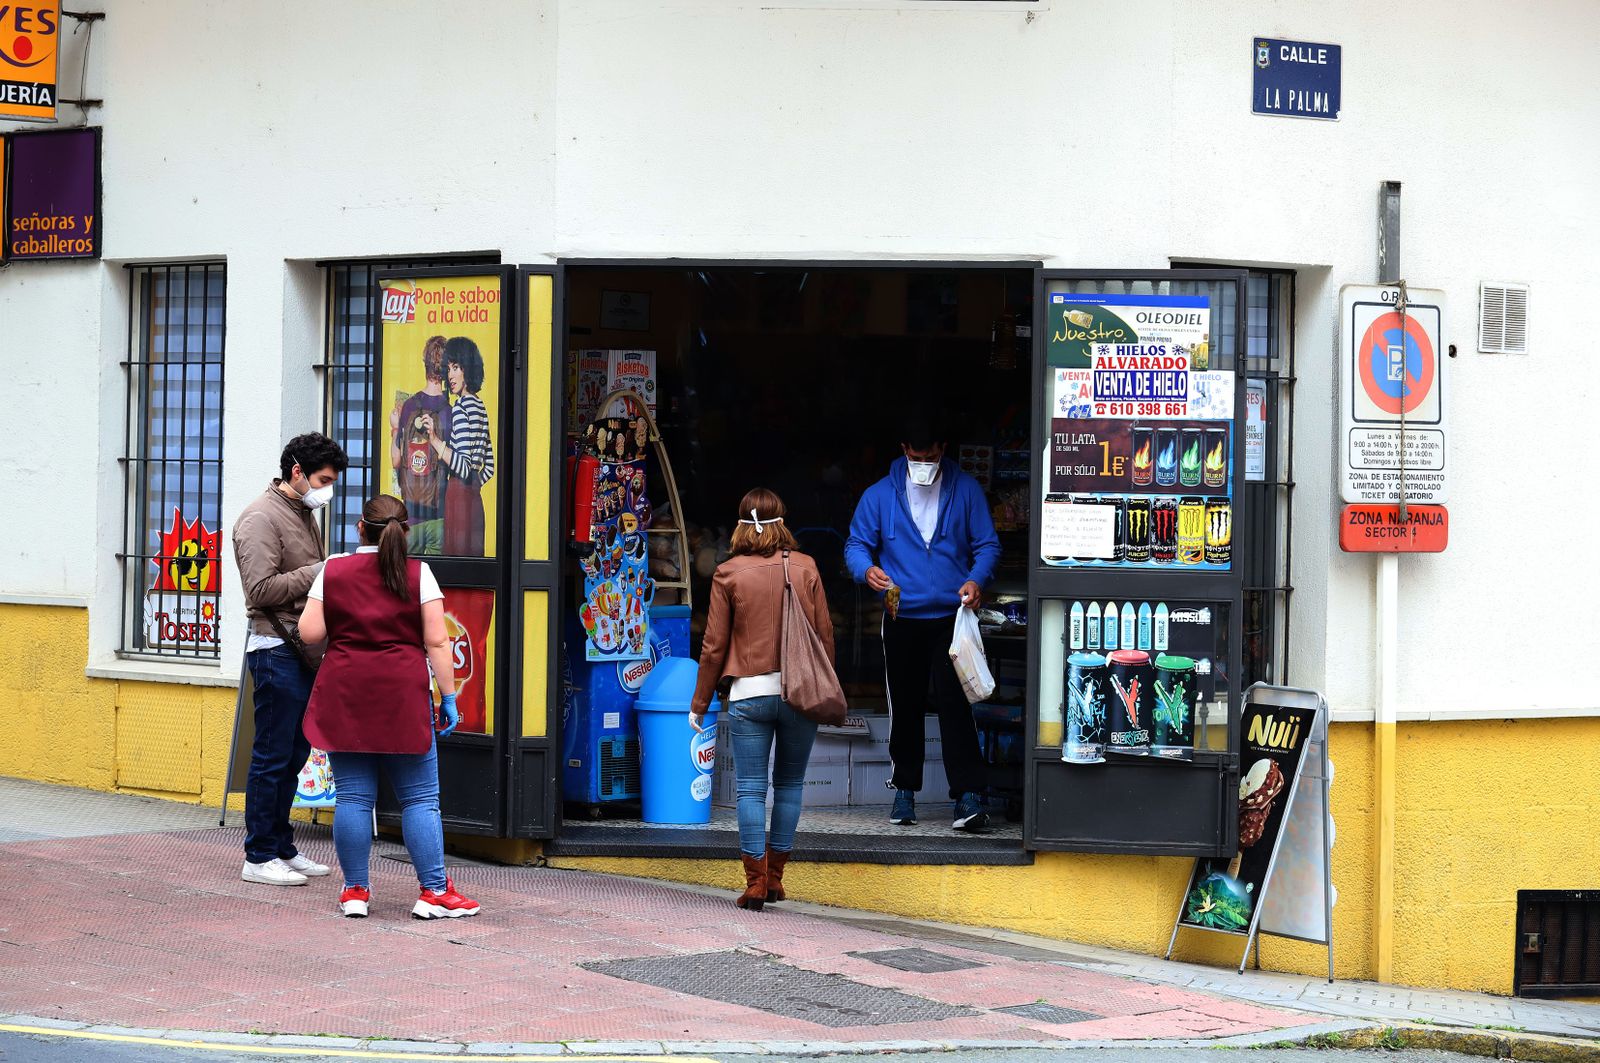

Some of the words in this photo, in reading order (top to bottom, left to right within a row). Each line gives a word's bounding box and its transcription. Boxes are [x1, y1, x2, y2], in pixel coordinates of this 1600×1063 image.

[1280, 45, 1327, 65] CALLE
[1265, 87, 1281, 109] LA
[1289, 89, 1329, 113] PALMA
[13, 212, 76, 232] señoras
[84, 214, 94, 233] y
[12, 235, 93, 255] caballeros
[415, 287, 455, 305] Ponle
[427, 310, 437, 324] a
[441, 306, 454, 324] la
[457, 304, 489, 324] vida
[1135, 311, 1203, 326] OLEODIEL
[1052, 318, 1125, 343] Nuestro
[1116, 344, 1166, 356] HIELOS
[1096, 357, 1187, 370] ALVARADO
[1062, 372, 1091, 381] VENTA
[1095, 371, 1132, 396] VENTA
[1135, 371, 1151, 396] DE
[1153, 371, 1187, 396] HIELO
[1110, 403, 1135, 416] 610
[1138, 403, 1160, 416] 398
[1165, 403, 1187, 416] 661
[1054, 433, 1070, 444] TU
[1072, 434, 1096, 445] LATA
[1367, 432, 1385, 440] Lunes
[1395, 432, 1417, 440] Virnes
[1055, 466, 1072, 476] POR
[1074, 463, 1096, 476] SÓLO
[1349, 512, 1383, 524] ZONA
[1365, 527, 1407, 538] SECTOR
